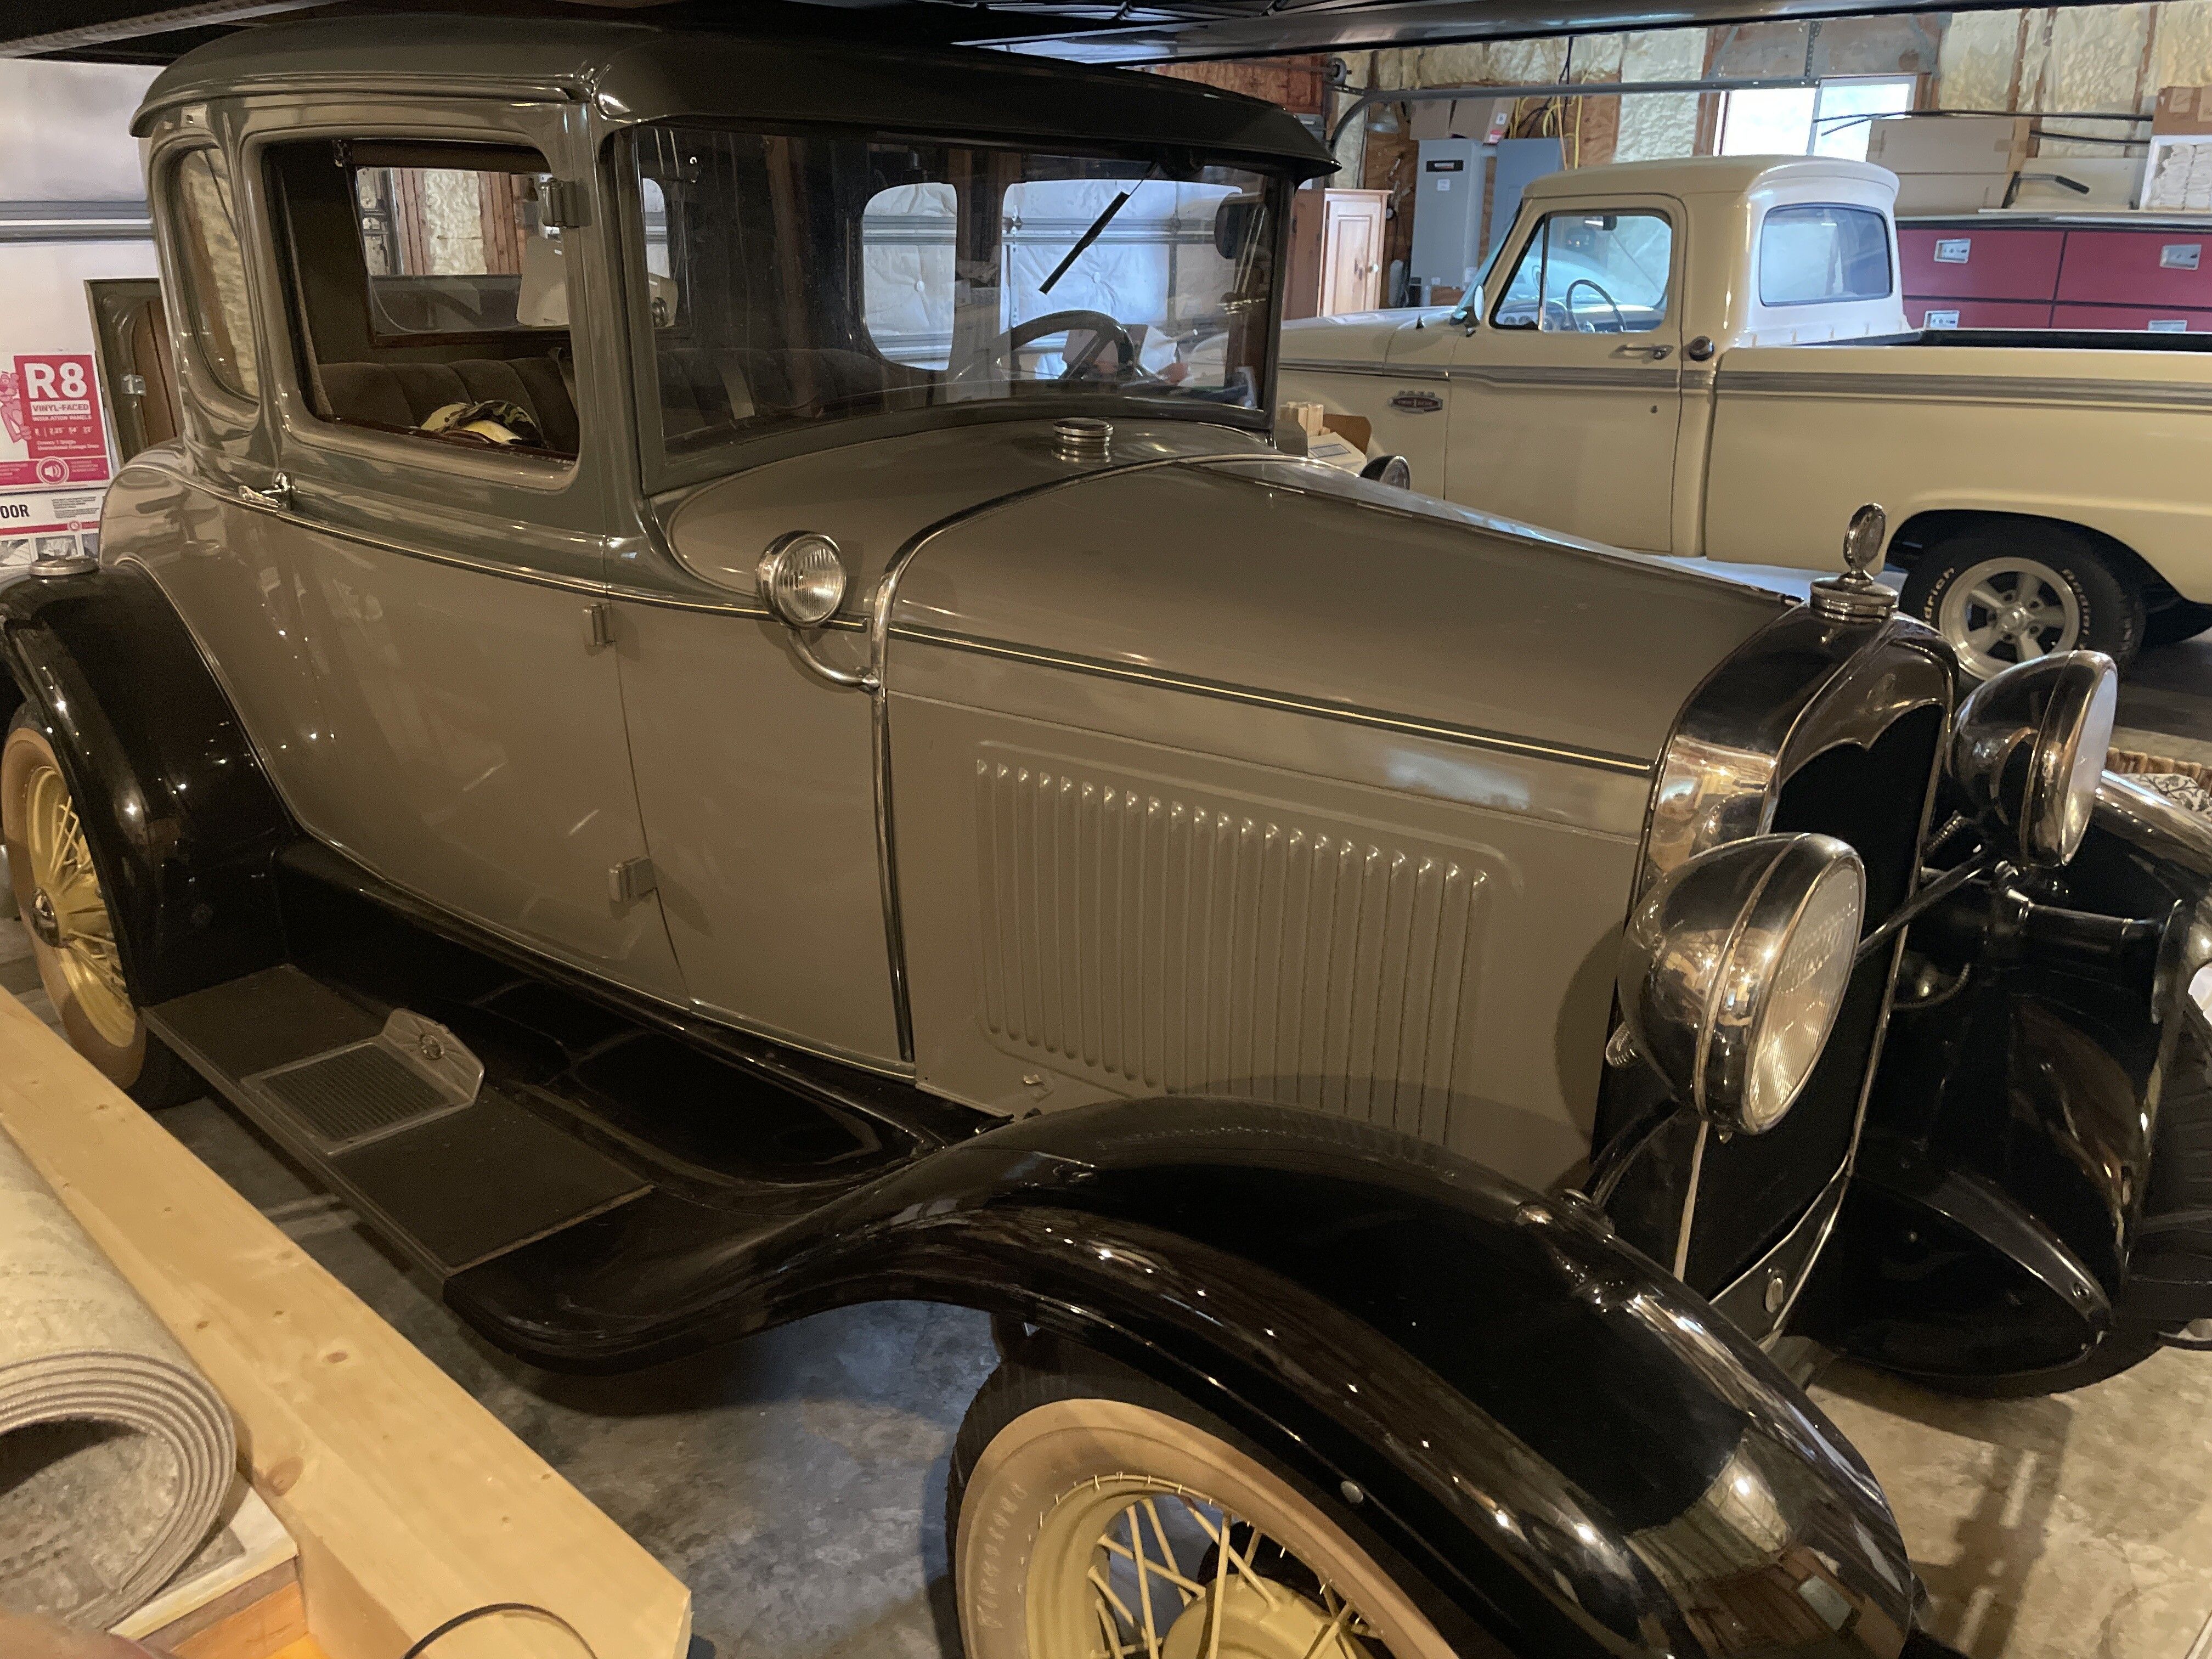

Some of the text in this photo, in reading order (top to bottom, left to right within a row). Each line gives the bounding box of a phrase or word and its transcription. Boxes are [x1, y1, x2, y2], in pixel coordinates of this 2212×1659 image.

[24, 362, 87, 399] R8
[32, 403, 89, 412] VINYL-FACED
[0, 504, 30, 519] OOR
[1923, 567, 1955, 625] drich
